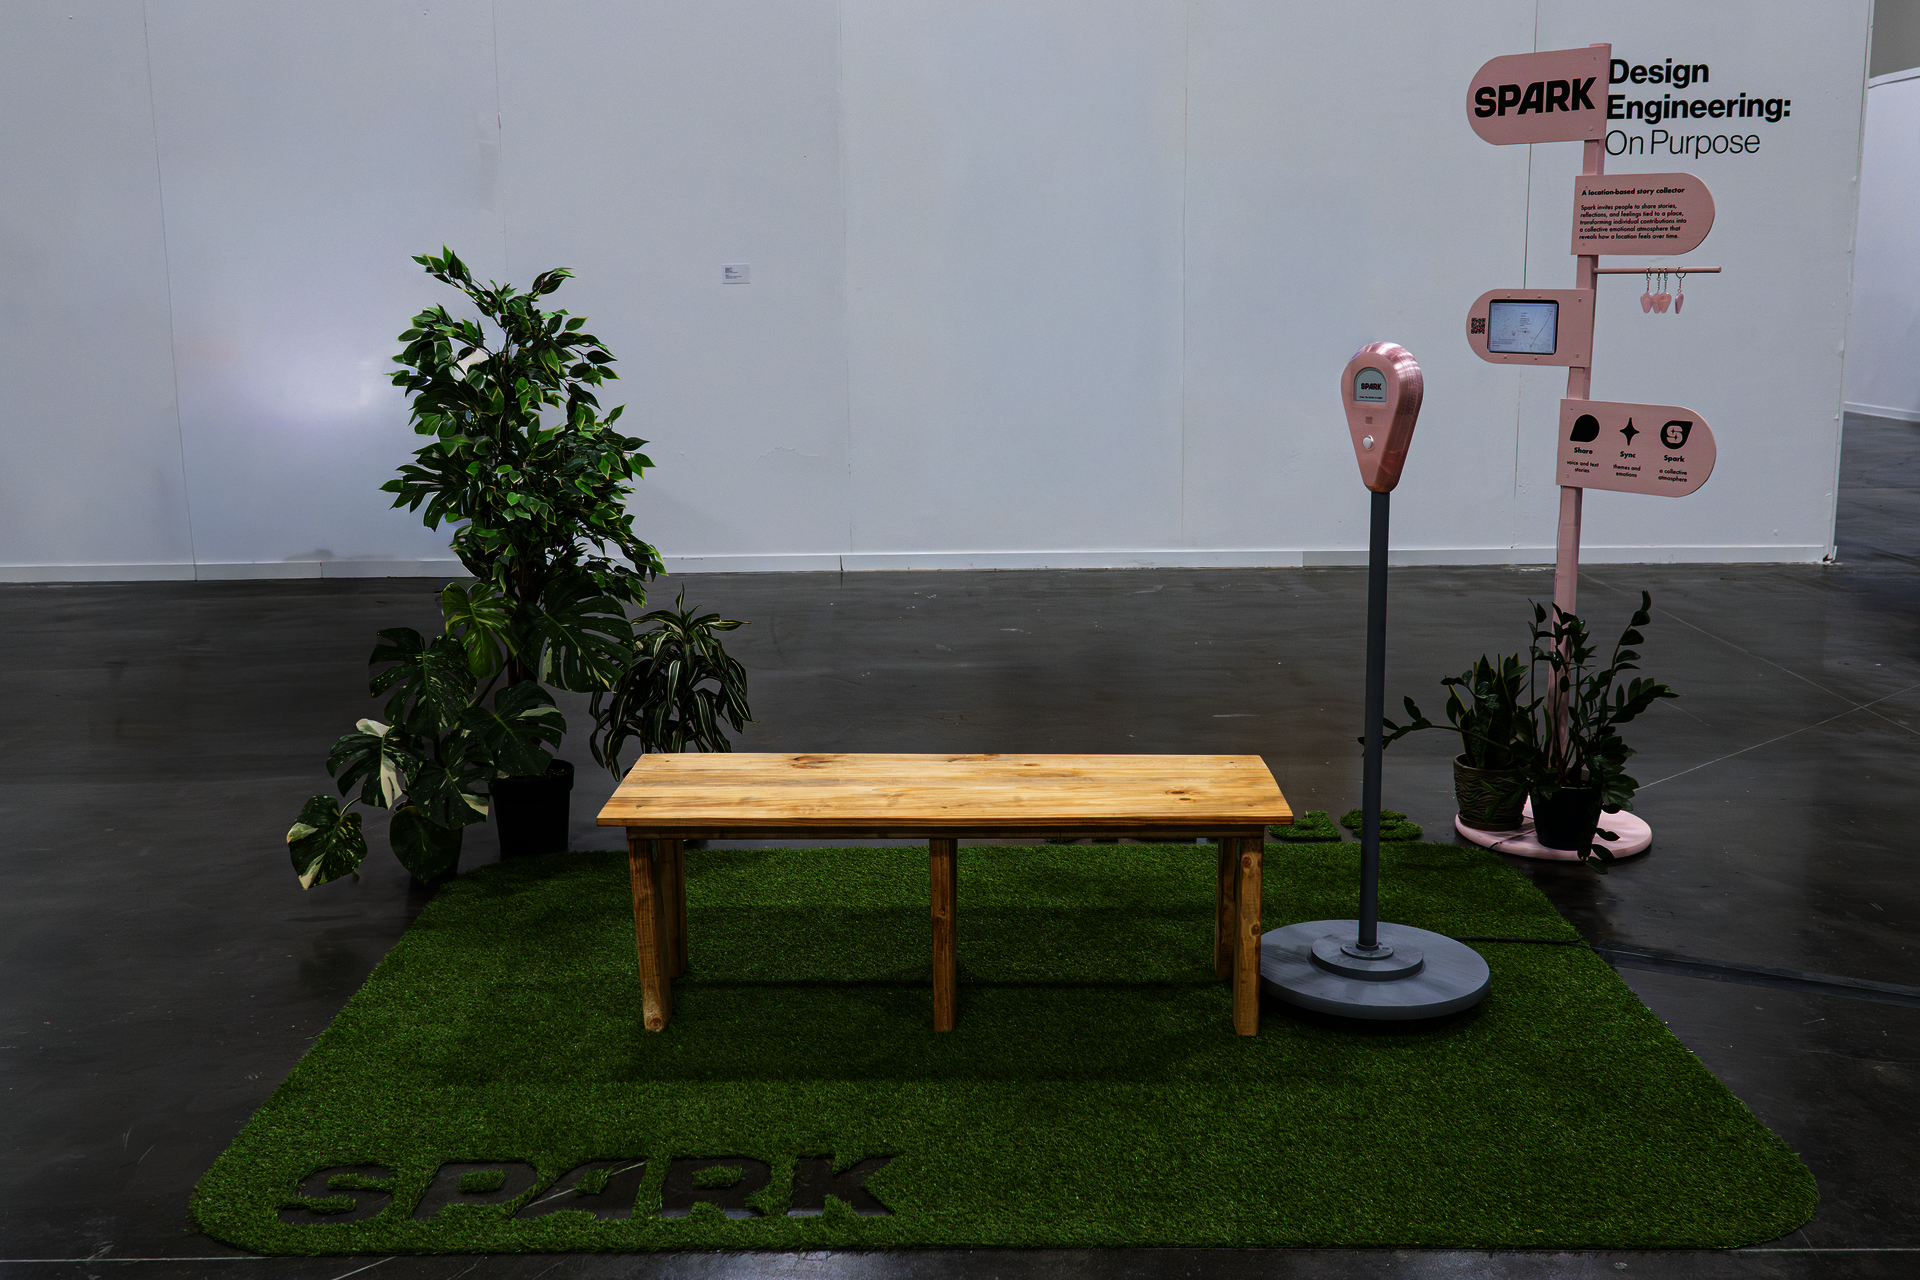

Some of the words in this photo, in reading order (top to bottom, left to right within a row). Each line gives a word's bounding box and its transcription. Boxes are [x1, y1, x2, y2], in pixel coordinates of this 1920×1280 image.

[1608, 58, 1710, 89] Design
[1474, 76, 1597, 118] SPARK
[1606, 92, 1791, 125] Engineering:
[1605, 130, 1644, 156] On
[1651, 129, 1761, 159] Purpose
[1588, 188, 1635, 196] location-based
[1637, 188, 1654, 196] story
[1574, 446, 1593, 454] Share
[1620, 450, 1636, 459] Sync
[1663, 454, 1685, 462] Spark
[277, 1154, 899, 1226] SPARK
